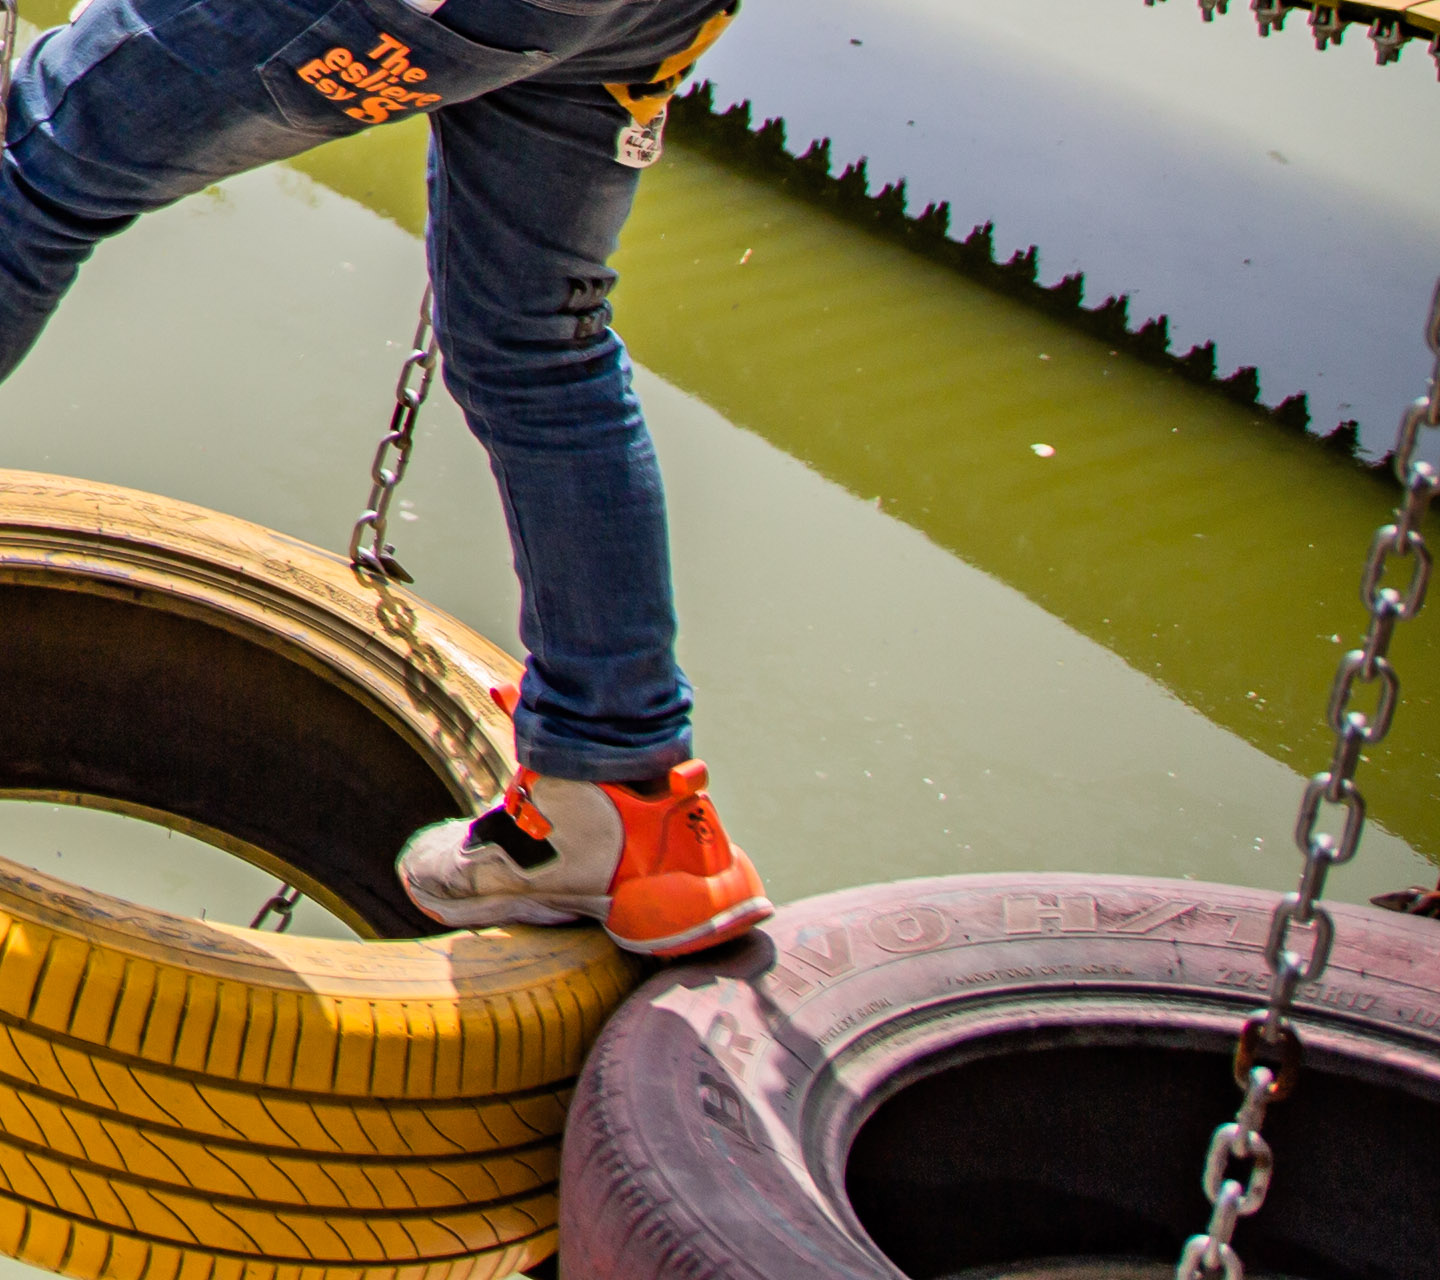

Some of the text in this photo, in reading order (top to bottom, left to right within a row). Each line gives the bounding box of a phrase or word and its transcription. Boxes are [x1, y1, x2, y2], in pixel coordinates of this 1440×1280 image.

[367, 32, 428, 84] The
[297, 58, 408, 124] Esy S
